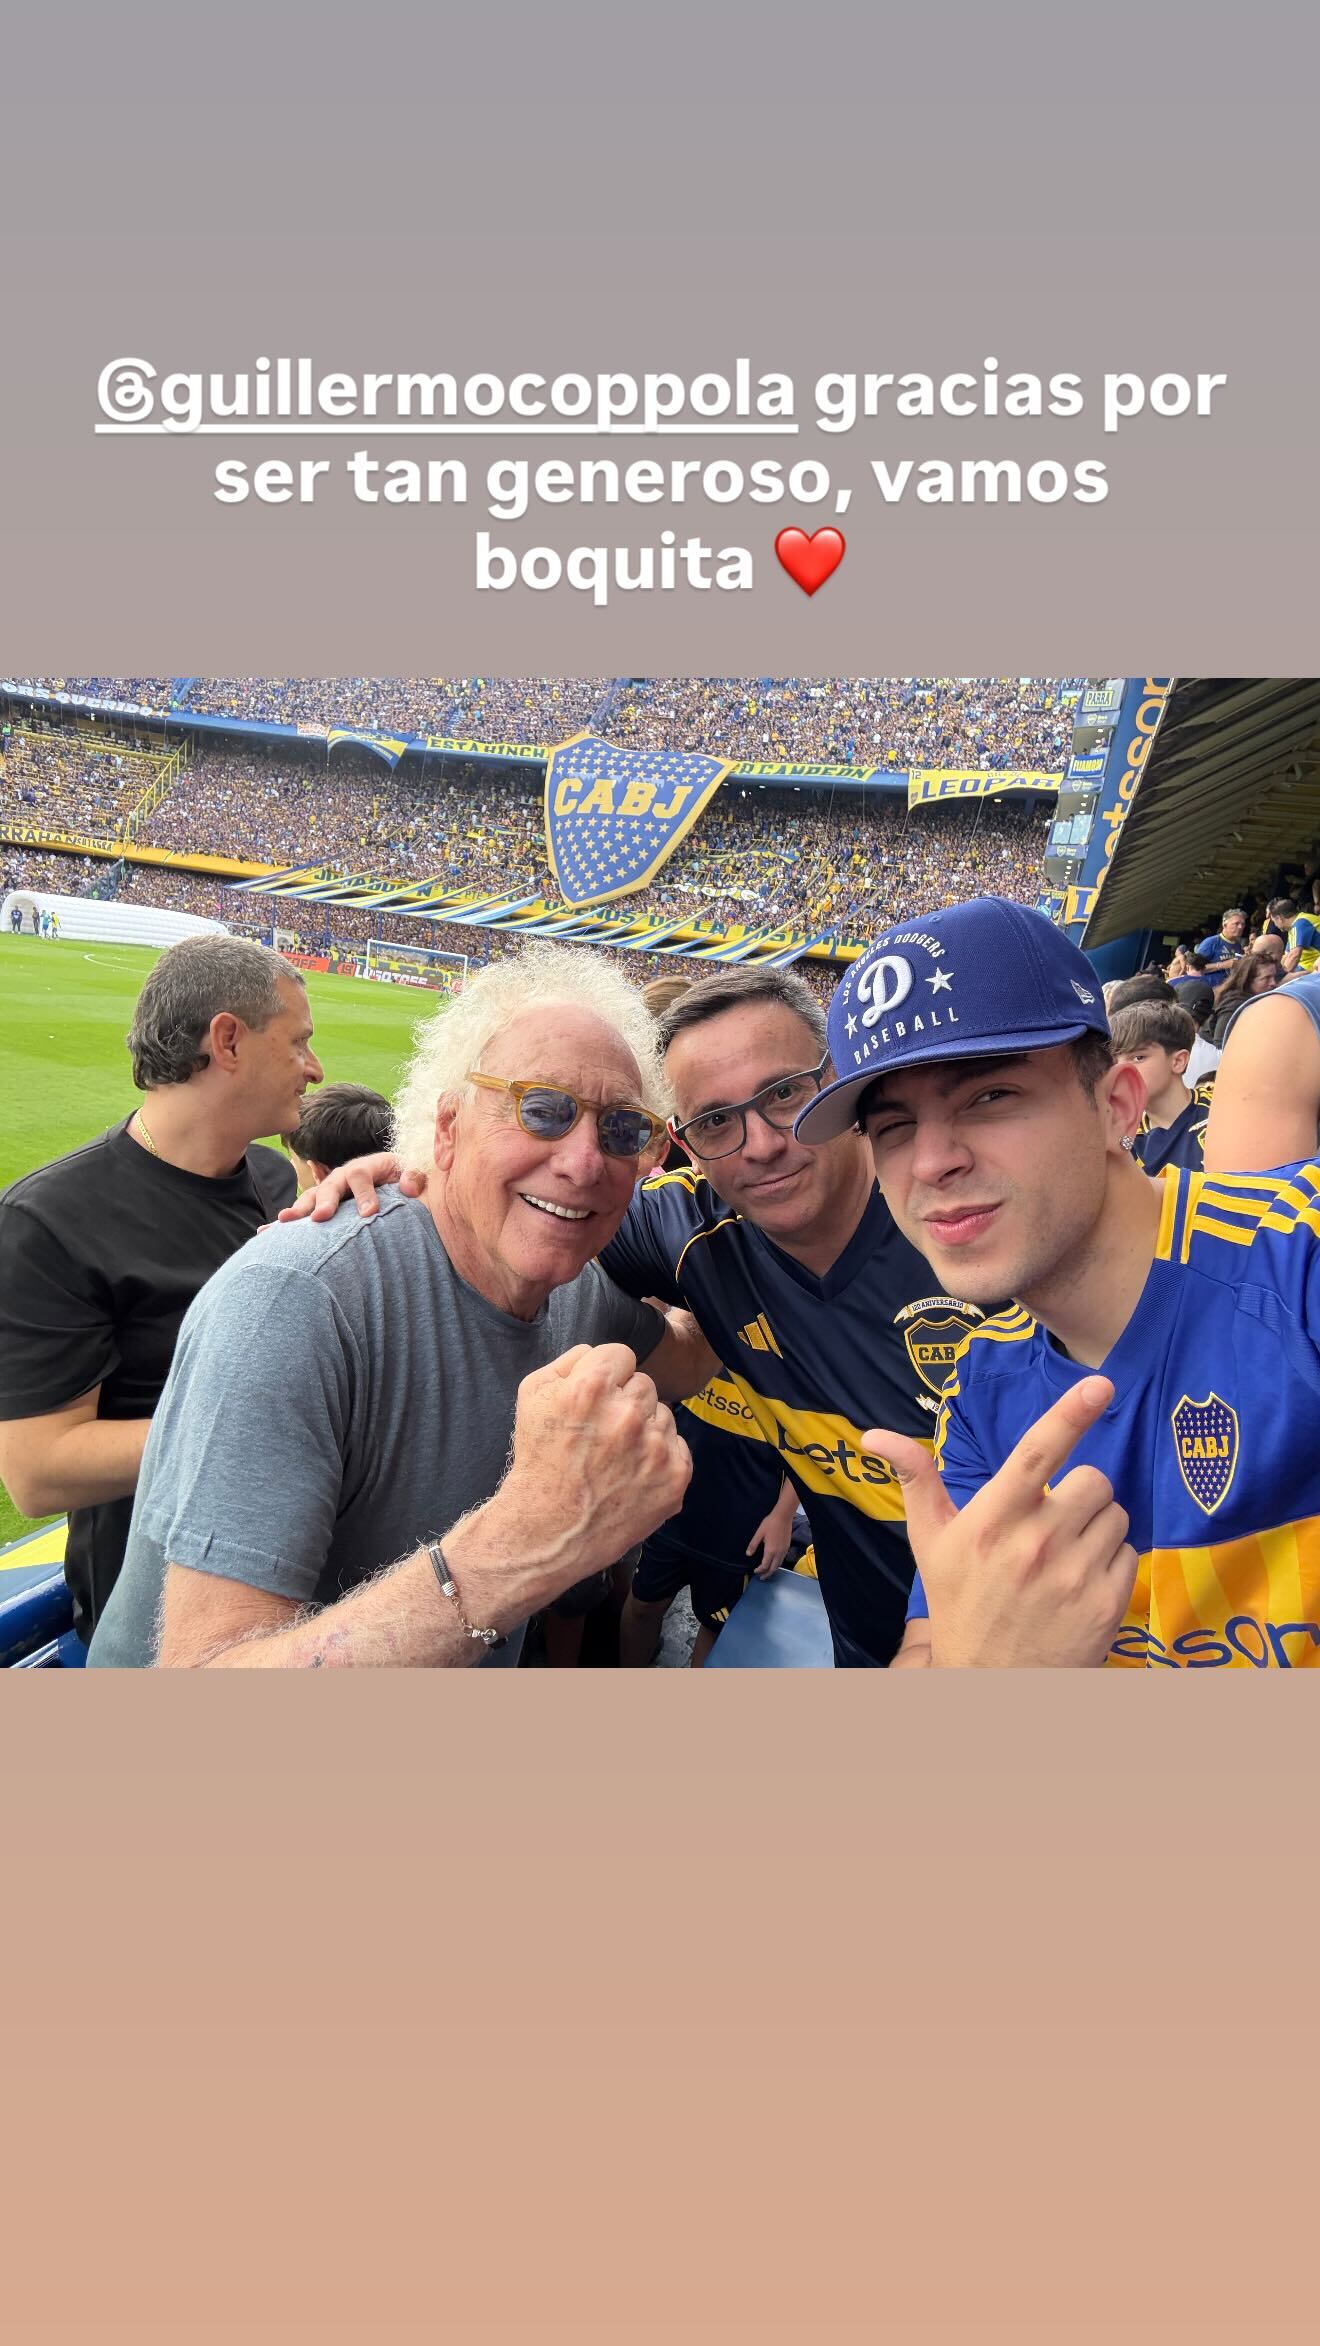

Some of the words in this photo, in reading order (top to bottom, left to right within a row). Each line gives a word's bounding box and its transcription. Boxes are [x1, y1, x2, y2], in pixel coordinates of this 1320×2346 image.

[553, 778, 694, 819] CABJ
[894, 932, 946, 958] DODGERS
[857, 955, 912, 1028] D
[853, 1006, 959, 1065] BASEBALL
[921, 1299, 964, 1309] ANIVERSARIO
[918, 1346, 956, 1361] CAB
[775, 1418, 898, 1485] bets
[1181, 1434, 1229, 1459] CABJ
